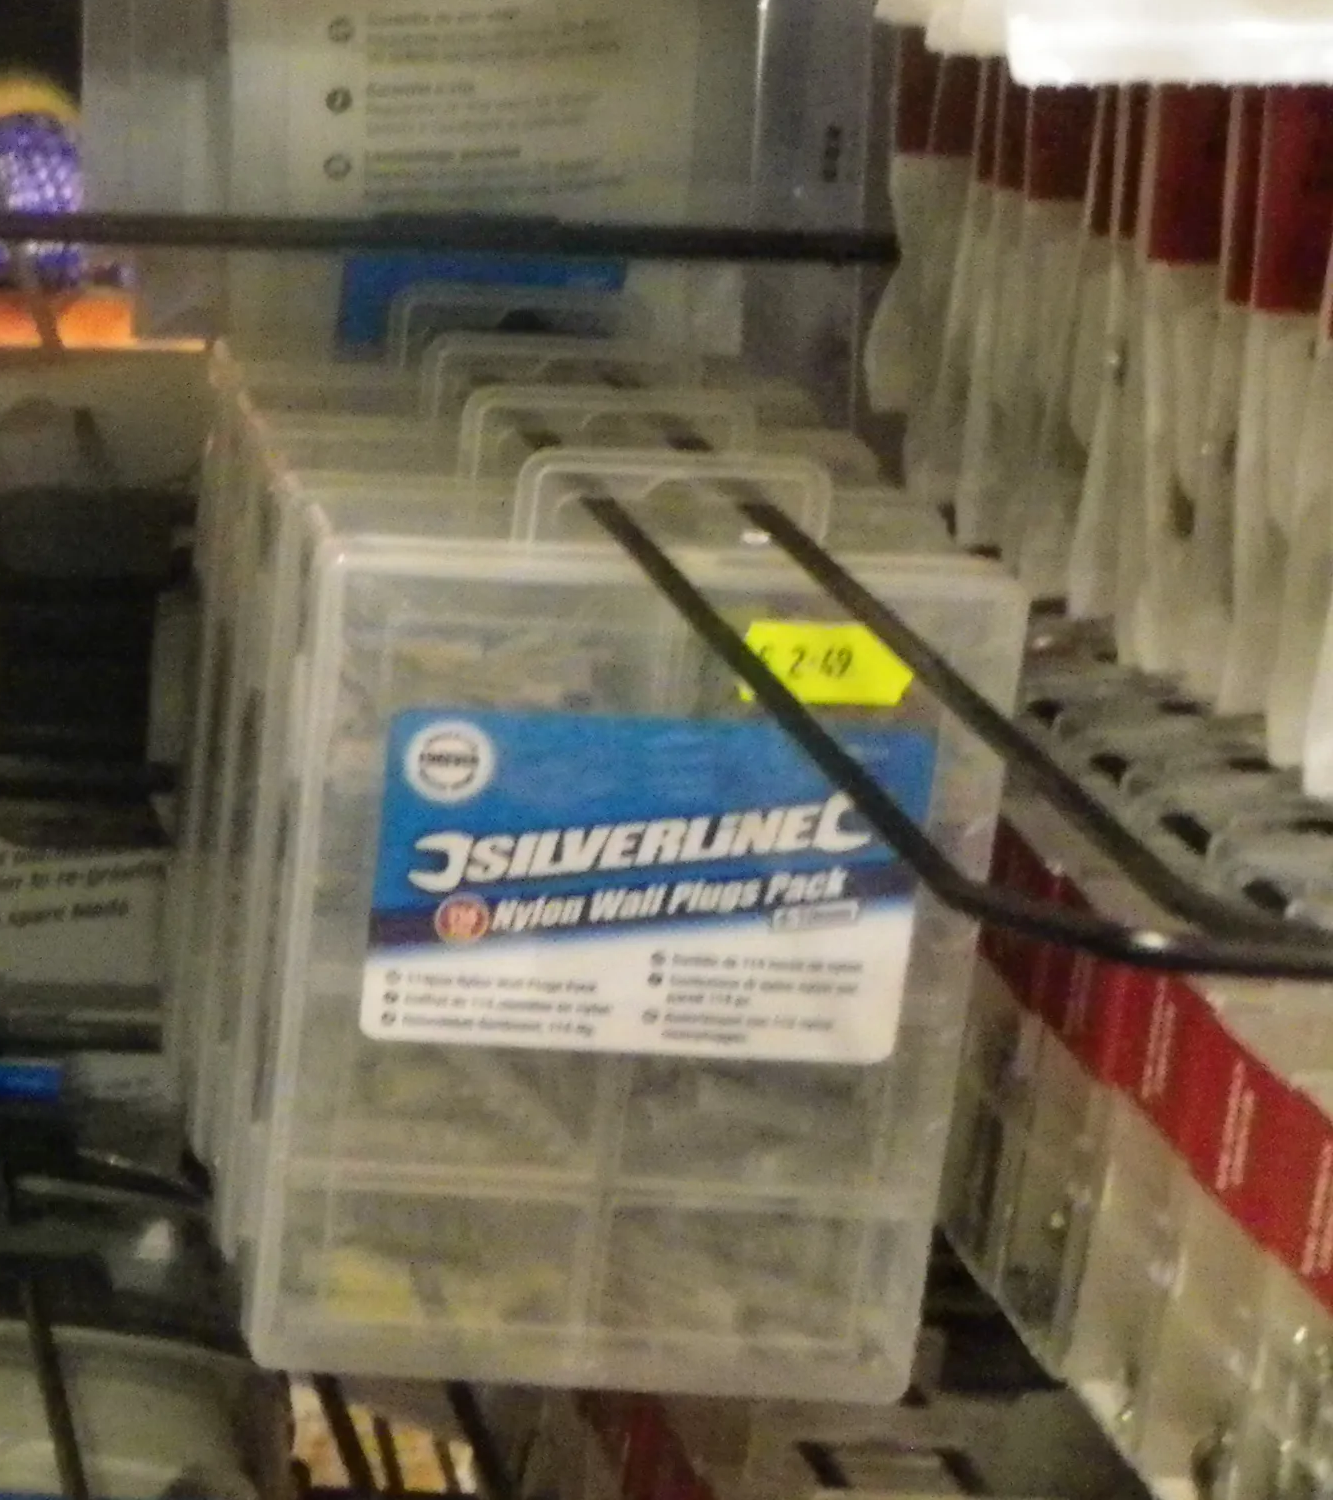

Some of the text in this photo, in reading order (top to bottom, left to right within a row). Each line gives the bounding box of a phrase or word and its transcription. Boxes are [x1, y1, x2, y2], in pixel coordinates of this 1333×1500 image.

[466, 804, 823, 884] SILVERLINE
[490, 895, 585, 933] Nylon
[587, 881, 667, 922] Wall
[667, 877, 763, 915] Plugs
[764, 865, 849, 904] Pack
